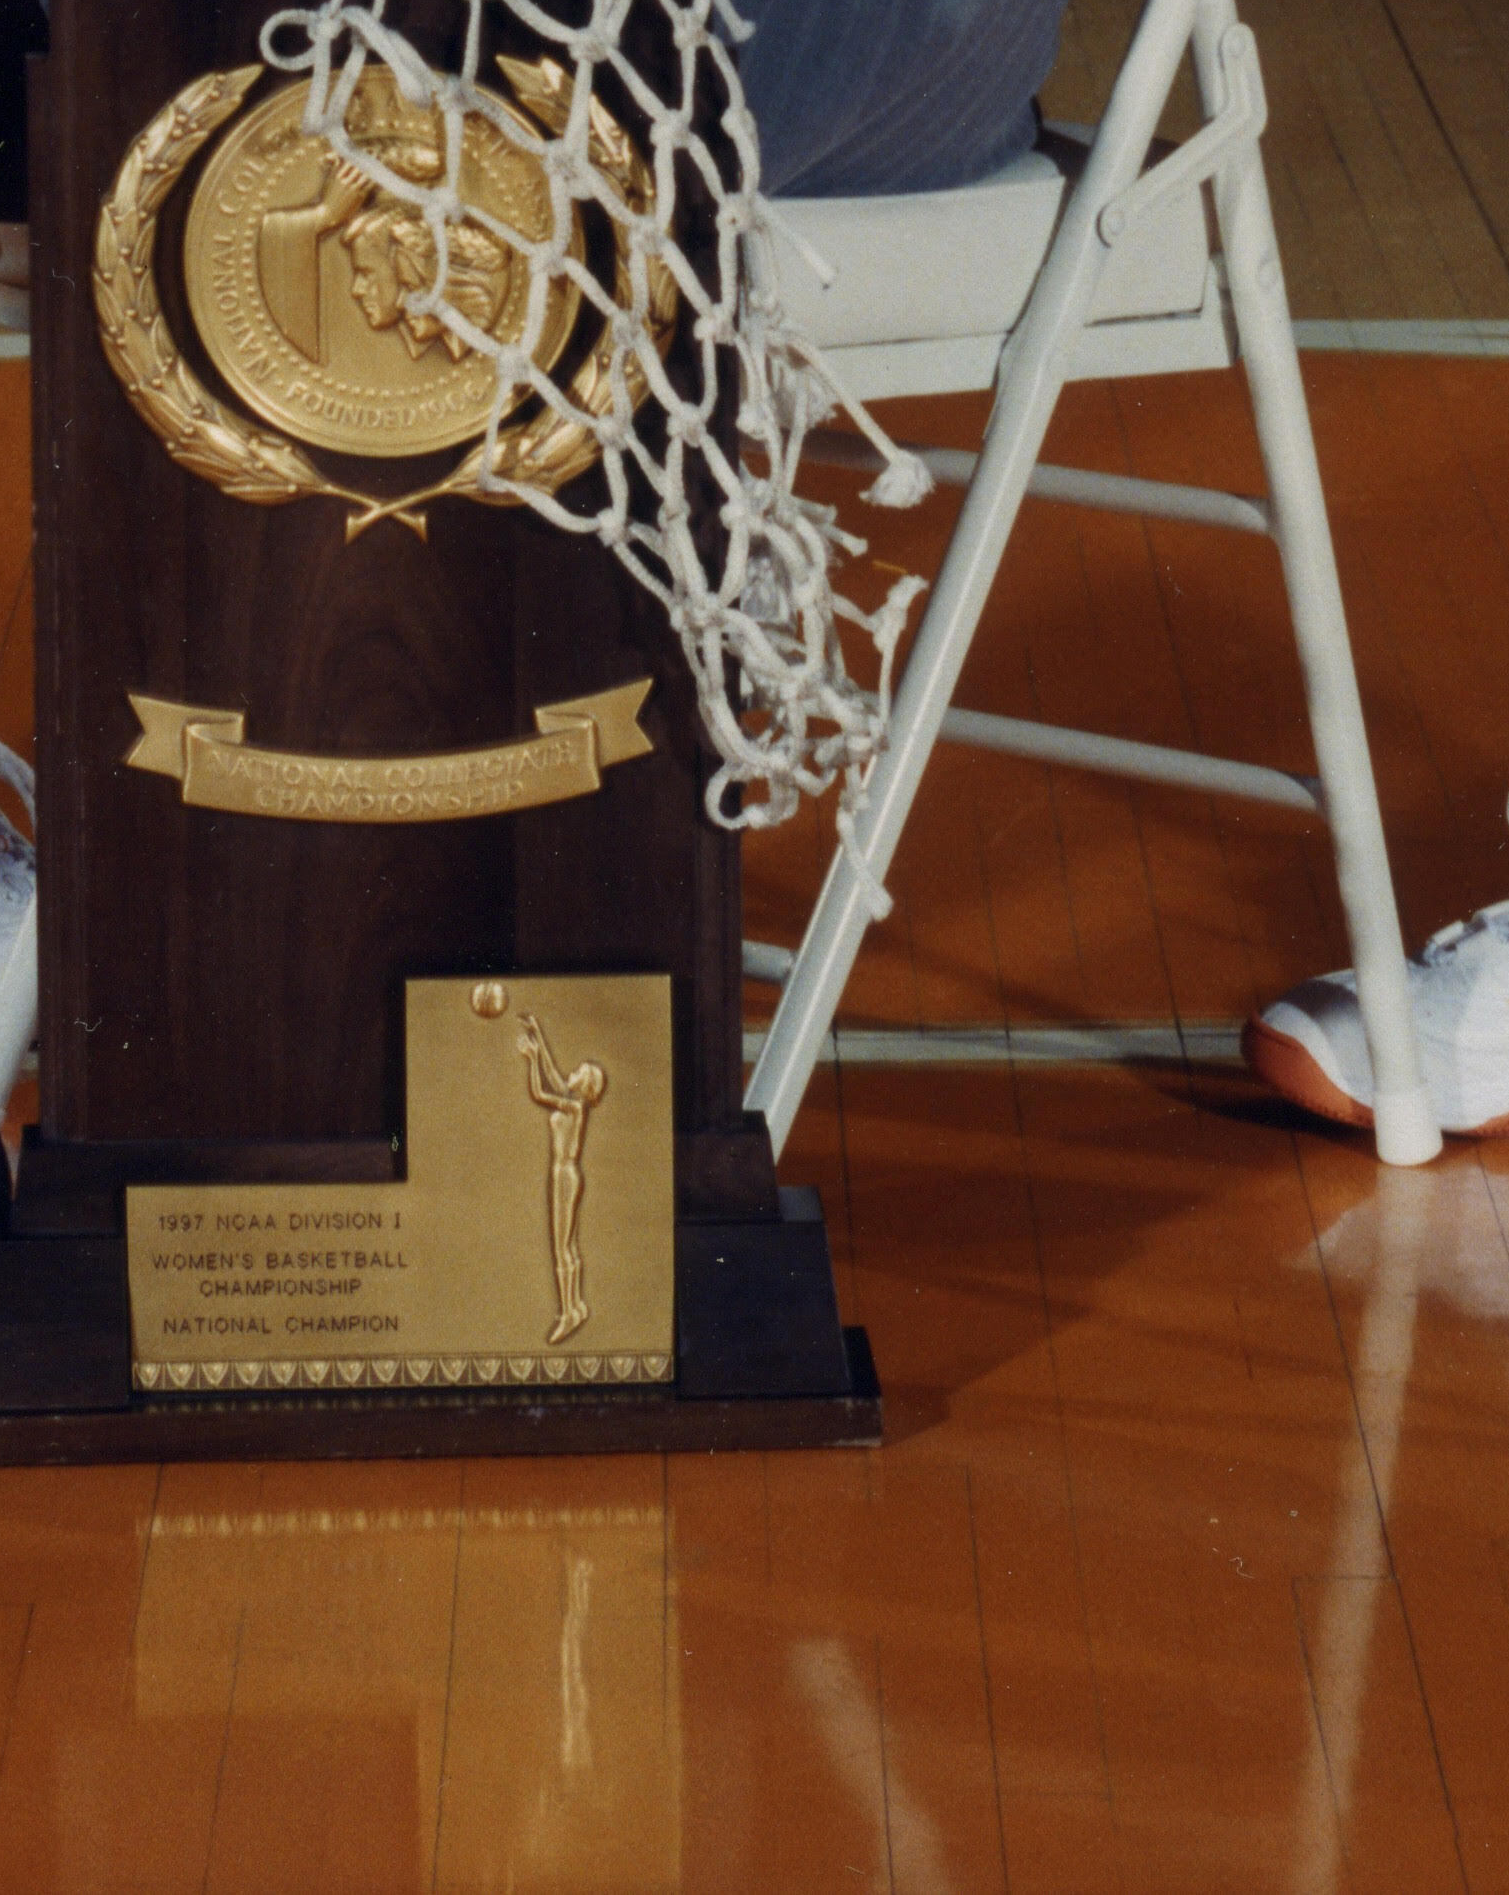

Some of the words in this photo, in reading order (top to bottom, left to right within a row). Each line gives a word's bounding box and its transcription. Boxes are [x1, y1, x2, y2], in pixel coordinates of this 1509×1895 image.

[286, 381, 415, 428] FOUNDED
[208, 749, 374, 789] NATIONAL
[383, 740, 579, 788] COLLEGIATE
[255, 779, 525, 815] CHAMPIONSHIP
[157, 1214, 204, 1232] 1997
[215, 1213, 277, 1232] NCAA
[288, 1212, 382, 1231] DIVISION
[394, 1212, 402, 1230] I
[151, 1252, 254, 1271] WOMEN'S
[265, 1250, 410, 1270] BASKETBALL
[198, 1277, 362, 1298] CHAMPIONSHIP
[162, 1316, 272, 1335] NATIONAL
[284, 1314, 400, 1333] CHAMPION
